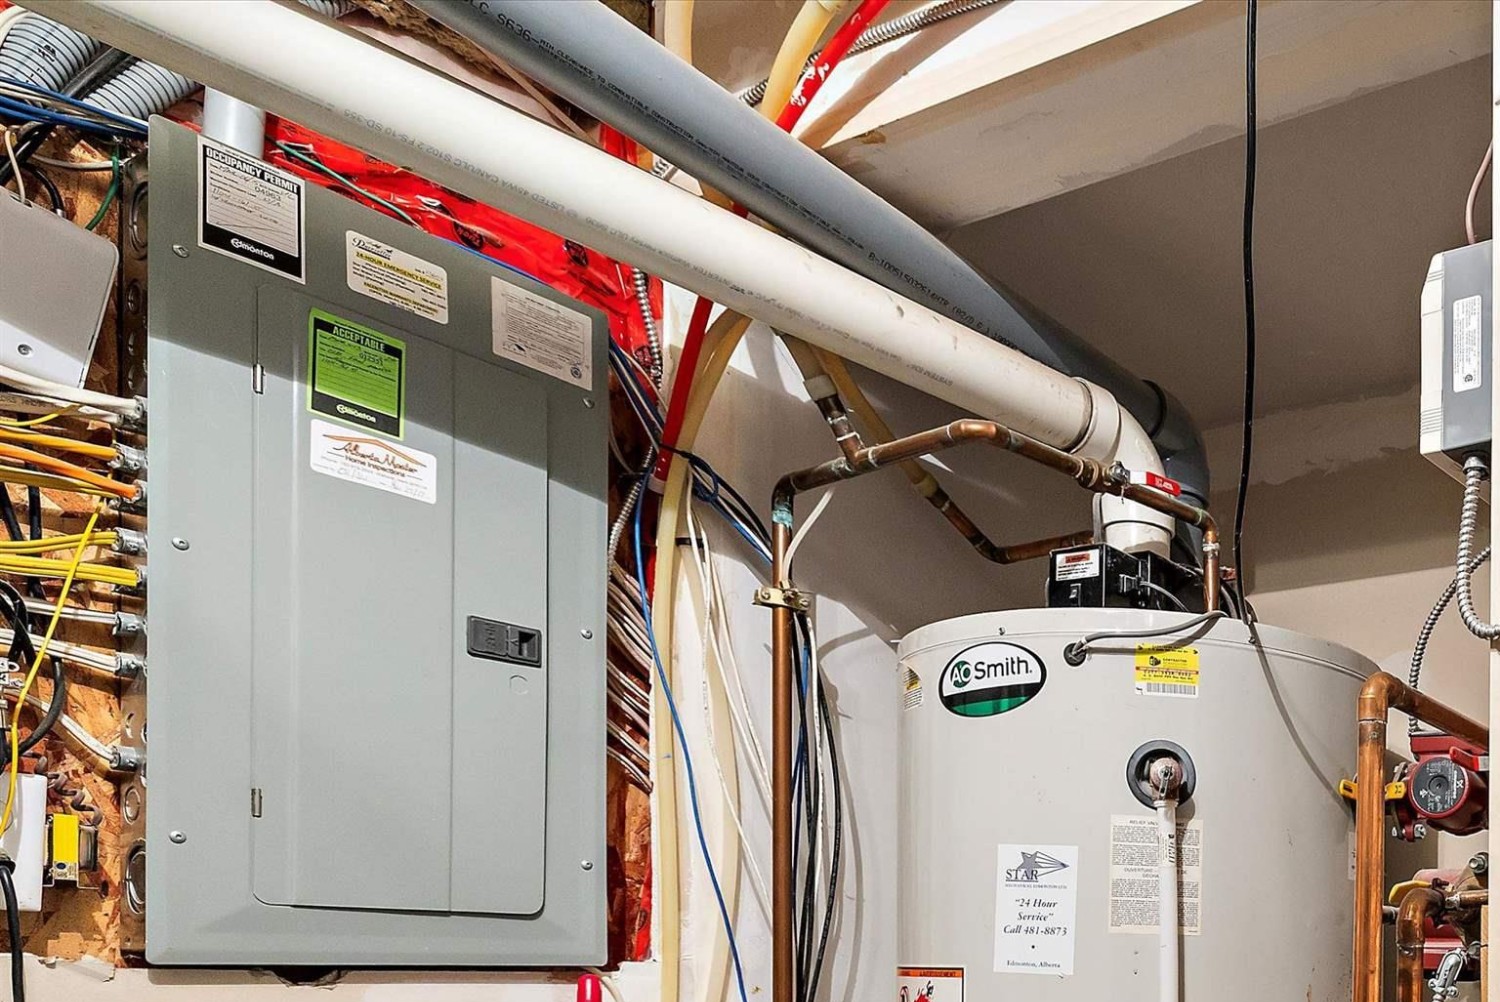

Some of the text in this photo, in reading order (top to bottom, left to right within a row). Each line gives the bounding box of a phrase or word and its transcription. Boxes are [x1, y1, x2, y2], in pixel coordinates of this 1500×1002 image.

[206, 147, 262, 179] OCCUPANCY
[264, 170, 299, 193] PERMIT
[230, 238, 275, 260] Edmonton
[332, 326, 386, 352] ACCEPTABLE
[345, 455, 406, 478] Home Inspections
[1005, 869, 1039, 881] STAR
[1033, 898, 1058, 908] Hour
[1003, 925, 1067, 937] Call 481-8873
[1006, 960, 1061, 968] Edmonton, Alberta
